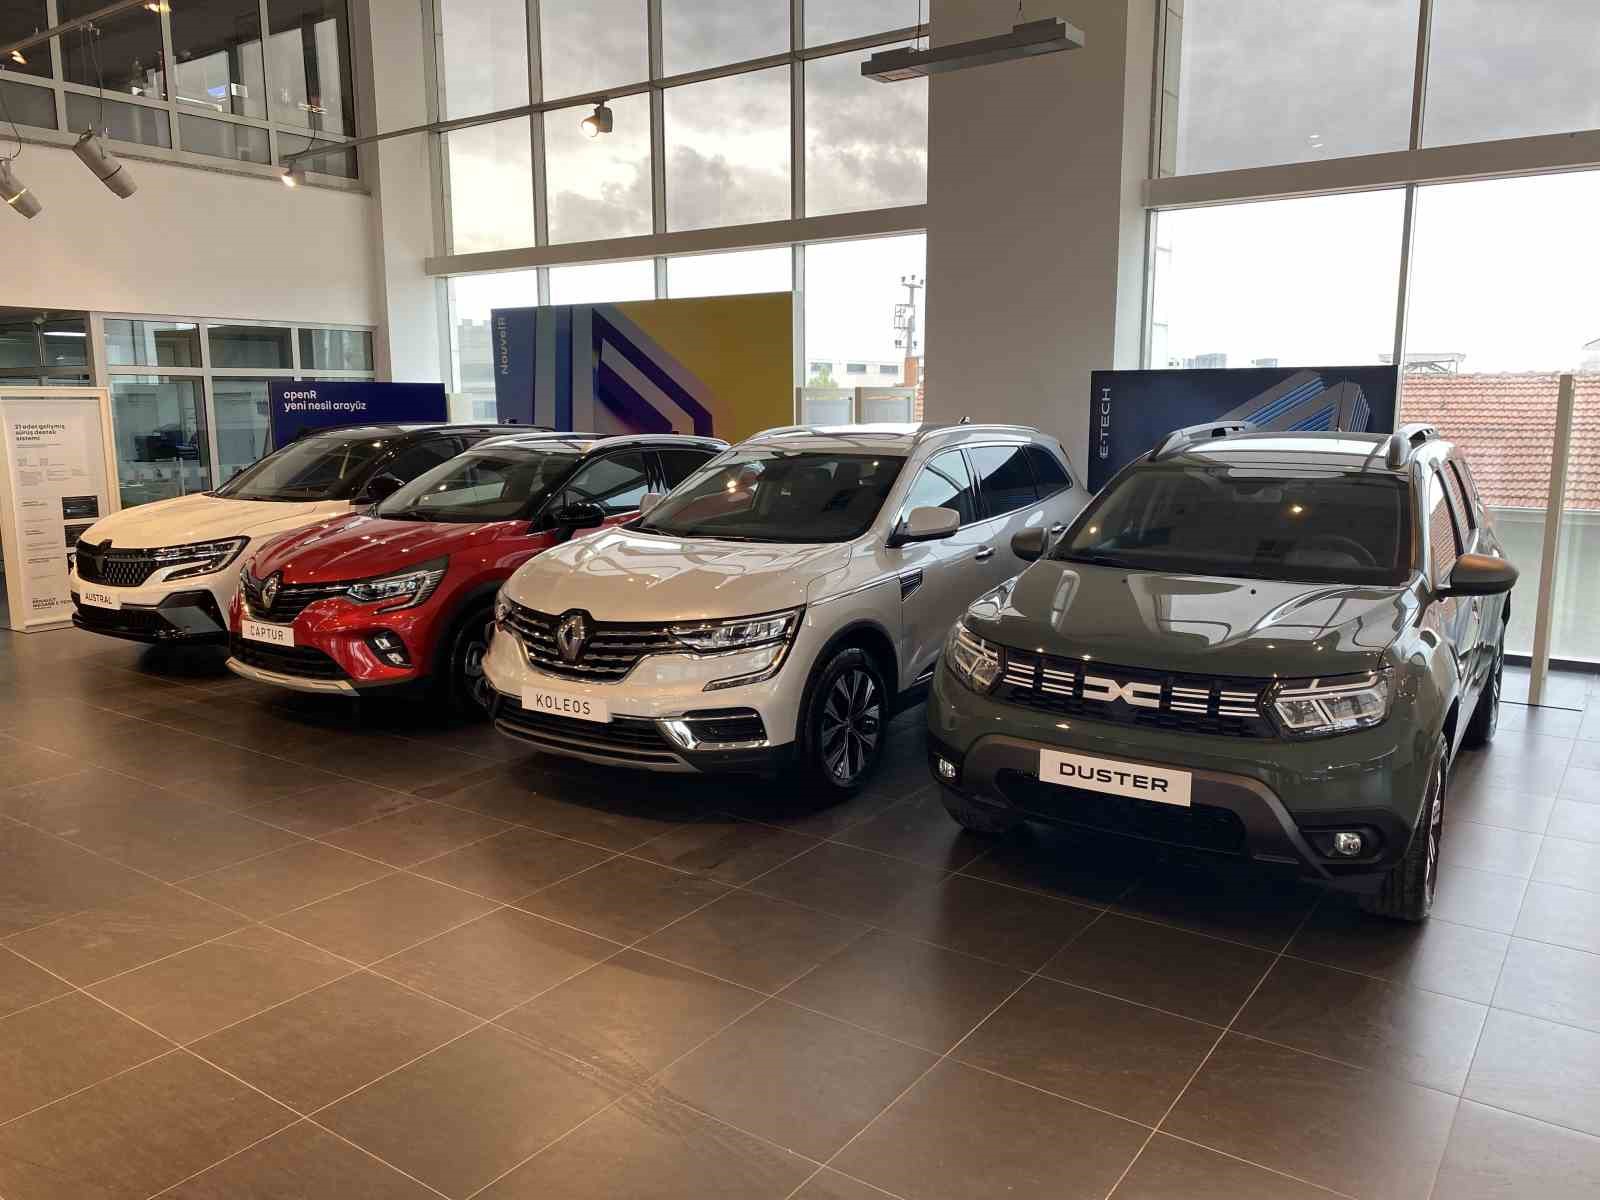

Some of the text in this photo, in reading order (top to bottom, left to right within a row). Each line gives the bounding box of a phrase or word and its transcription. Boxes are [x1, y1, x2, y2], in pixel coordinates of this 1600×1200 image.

[283, 390, 317, 401] openR
[284, 400, 367, 412] yeni nesil arayüz
[85, 592, 112, 605] AUSTRAL
[250, 624, 284, 641] CAPTUR
[535, 694, 591, 715] KOLEOS
[1059, 762, 1169, 793] DUSTER
